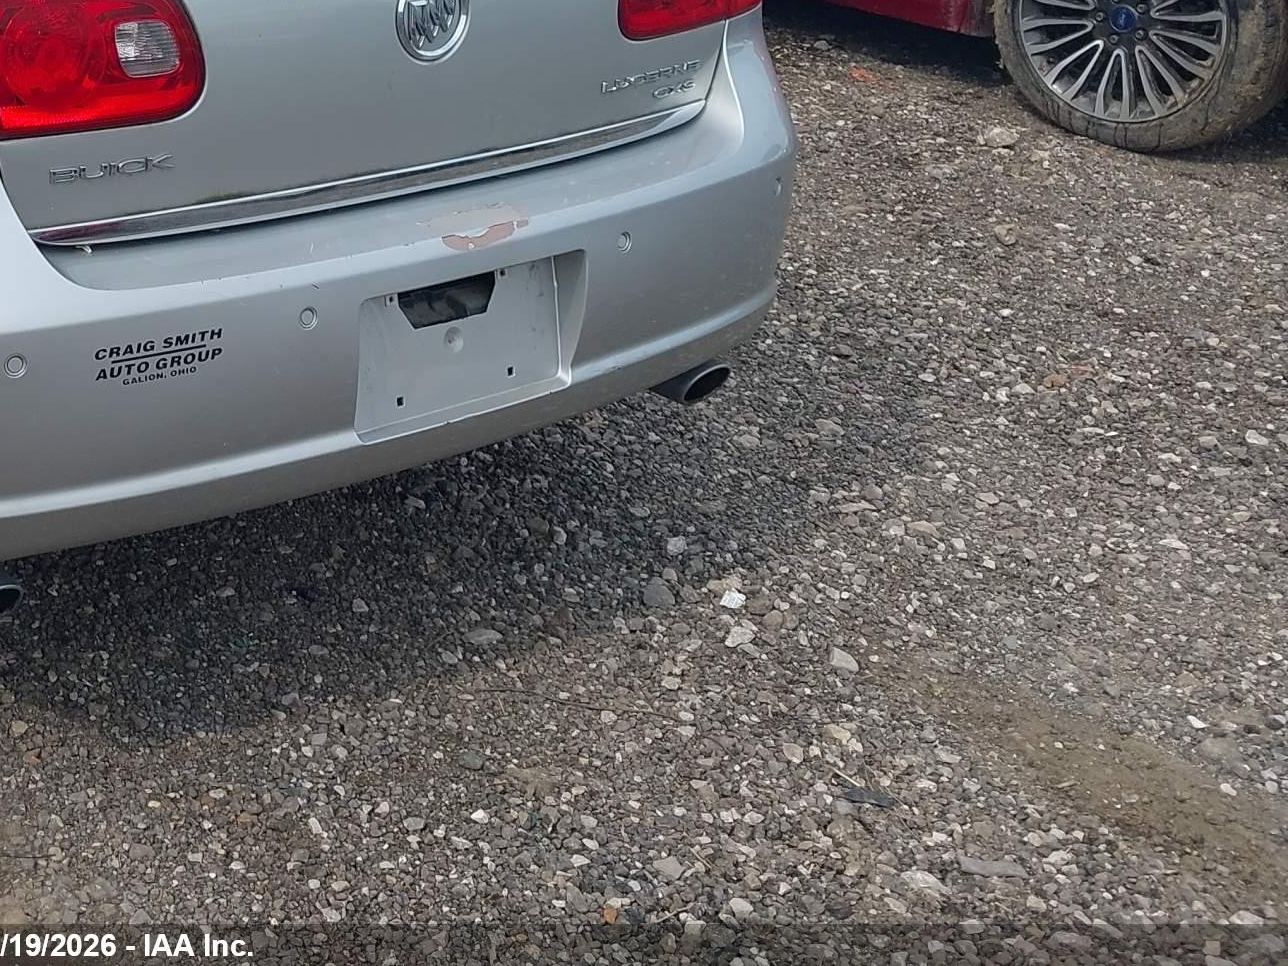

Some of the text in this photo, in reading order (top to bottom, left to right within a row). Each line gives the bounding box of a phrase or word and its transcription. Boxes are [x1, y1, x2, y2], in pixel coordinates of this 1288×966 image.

[600, 59, 702, 94] LUCERNE
[48, 153, 175, 185] BUICK
[94, 328, 223, 361] CRAIG SMITH
[95, 347, 223, 381] AUTO GROUP
[169, 366, 197, 377] OHIO
